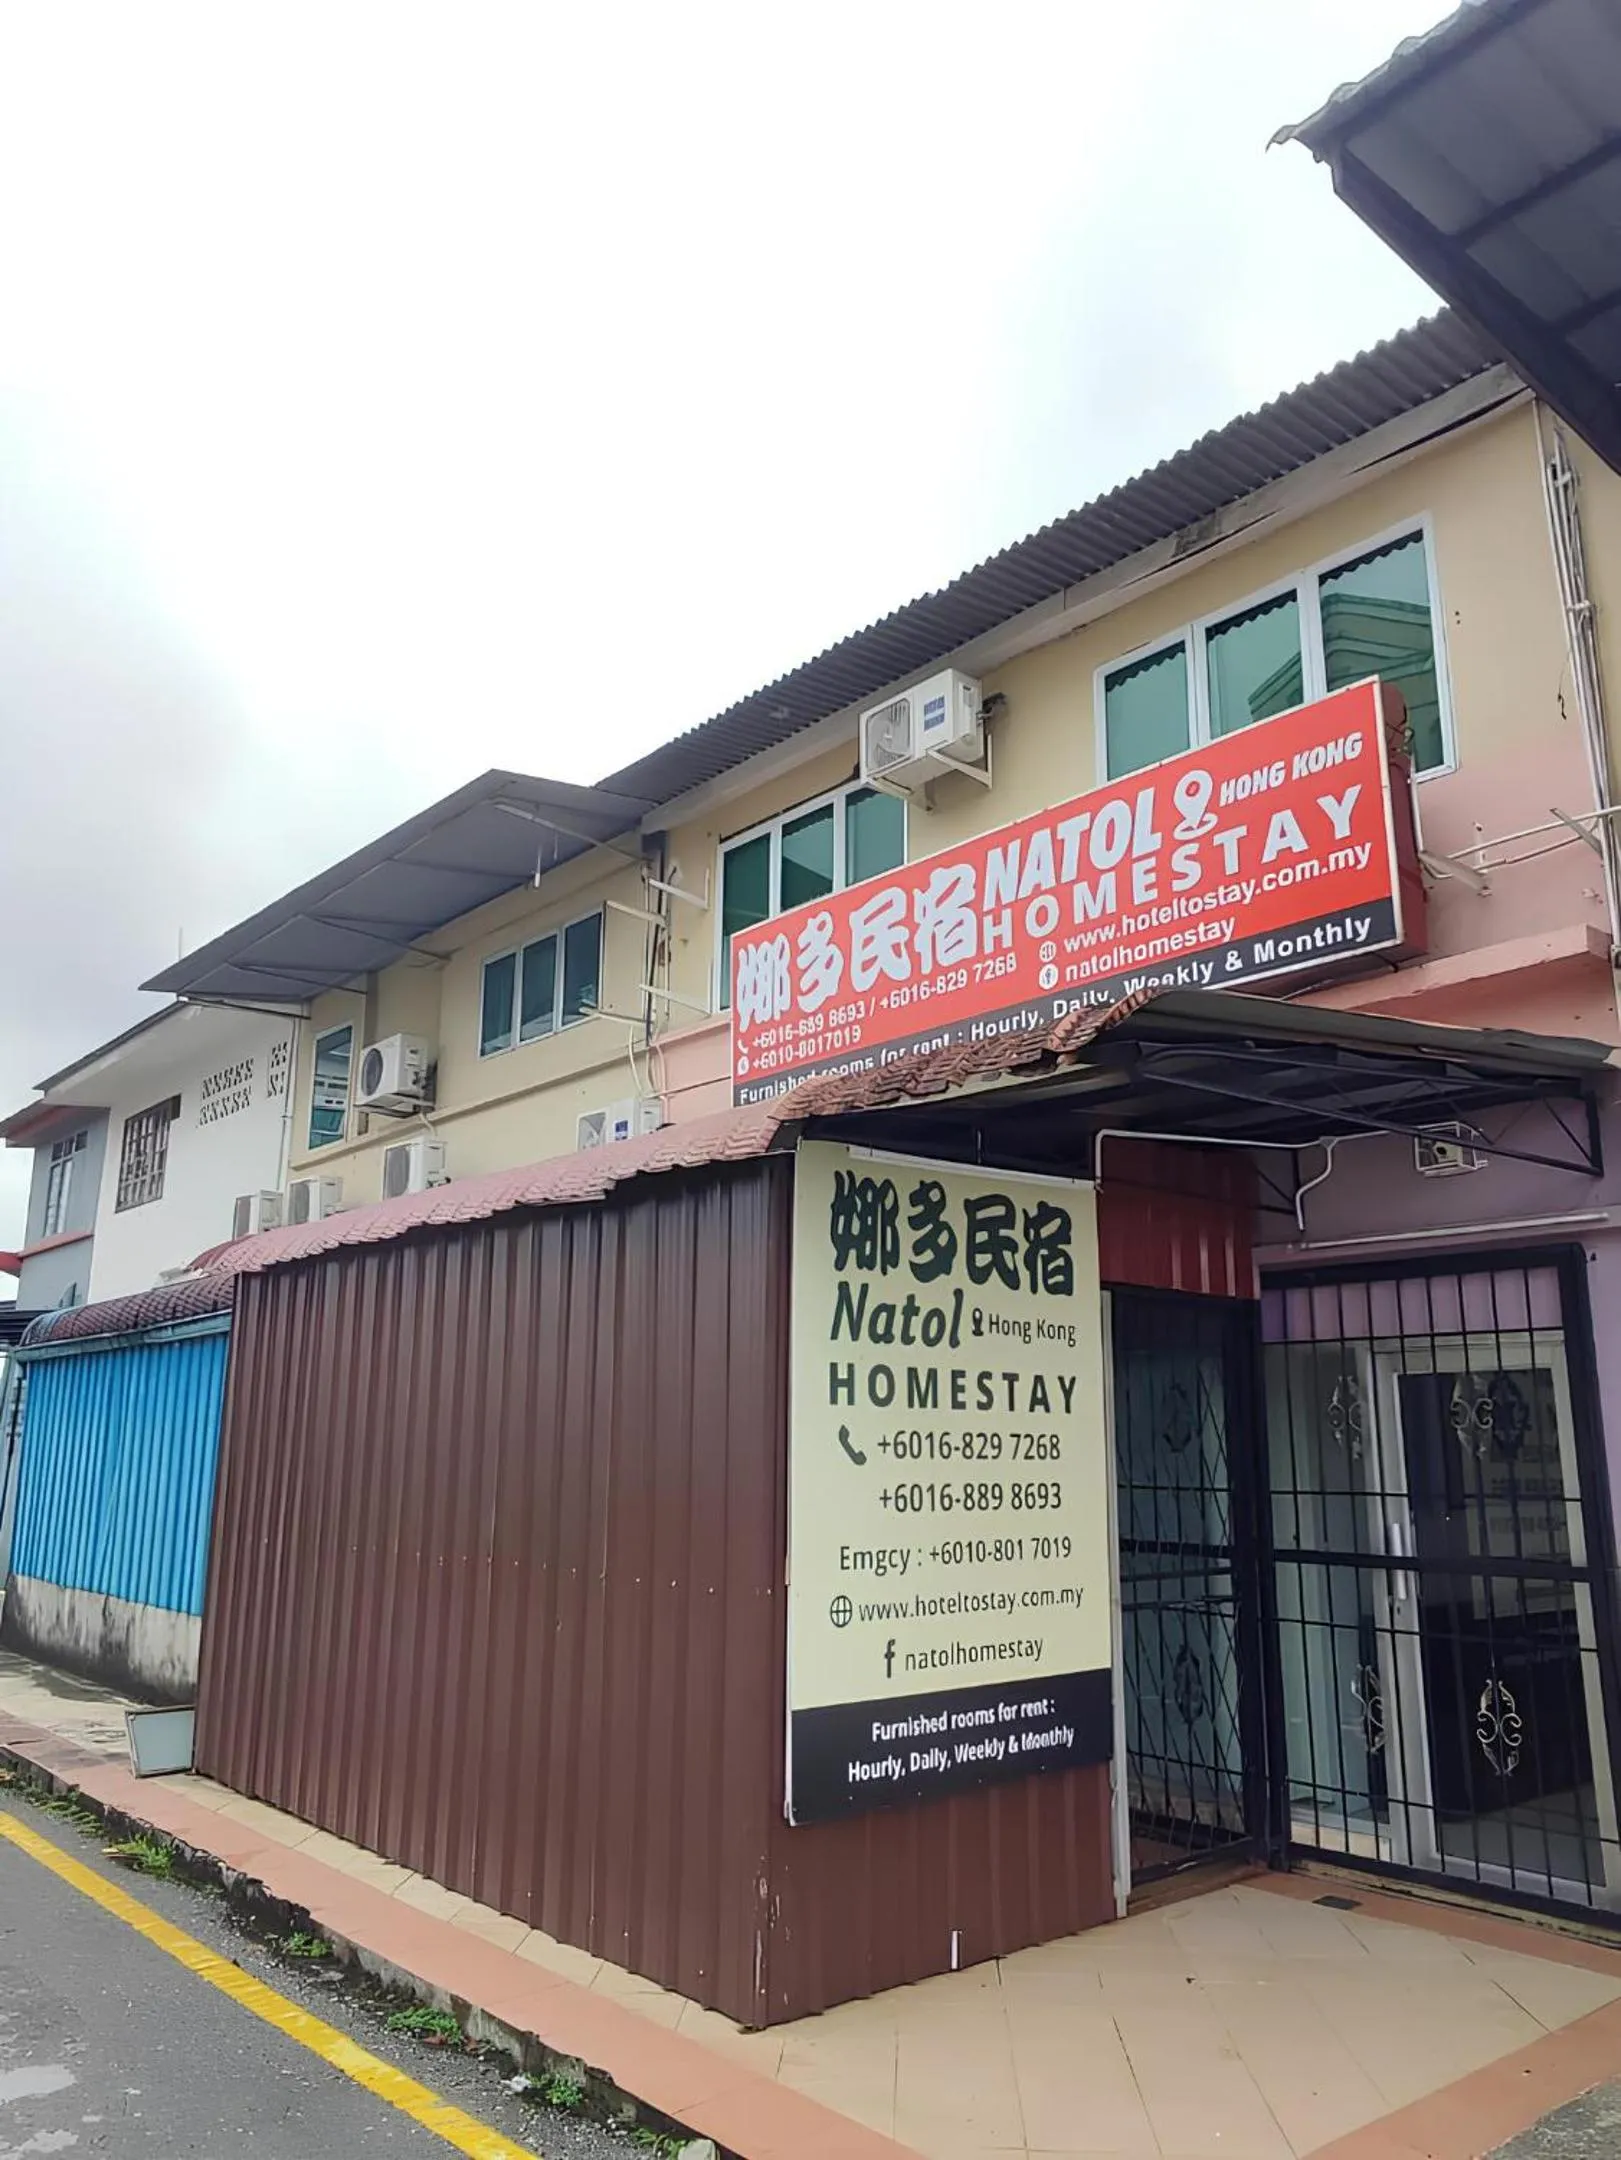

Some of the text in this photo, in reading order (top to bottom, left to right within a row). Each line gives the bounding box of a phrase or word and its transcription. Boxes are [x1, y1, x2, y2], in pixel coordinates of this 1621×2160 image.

[983, 732, 1363, 911] NATOL HONG KONG
[983, 784, 1362, 955] HOMESTAY
[1064, 843, 1372, 954] www.hoteltostay.com.my
[1065, 917, 1236, 983] natolhomestay
[1224, 949, 1244, 972] &
[1254, 915, 1372, 966] Monthly
[830, 1281, 1076, 1349] Natol Hong Kong
[829, 1362, 1077, 1414] HOMESTAY
[877, 1430, 1061, 1461] +6016-829 7268
[879, 1482, 1062, 1513] +6016-889 8693
[929, 1538, 1025, 1565] +6010-801
[1031, 1535, 1072, 1560] 7019
[859, 1585, 1084, 1623] www.hoteltostay.com.my
[905, 1637, 1044, 1672] natolhomestay
[872, 1711, 948, 1742] Furnished
[951, 1708, 995, 1730] rooms
[998, 1702, 1019, 1723] for
[849, 1725, 1075, 1782] Hourly, Daily, Weekly & Monthly
